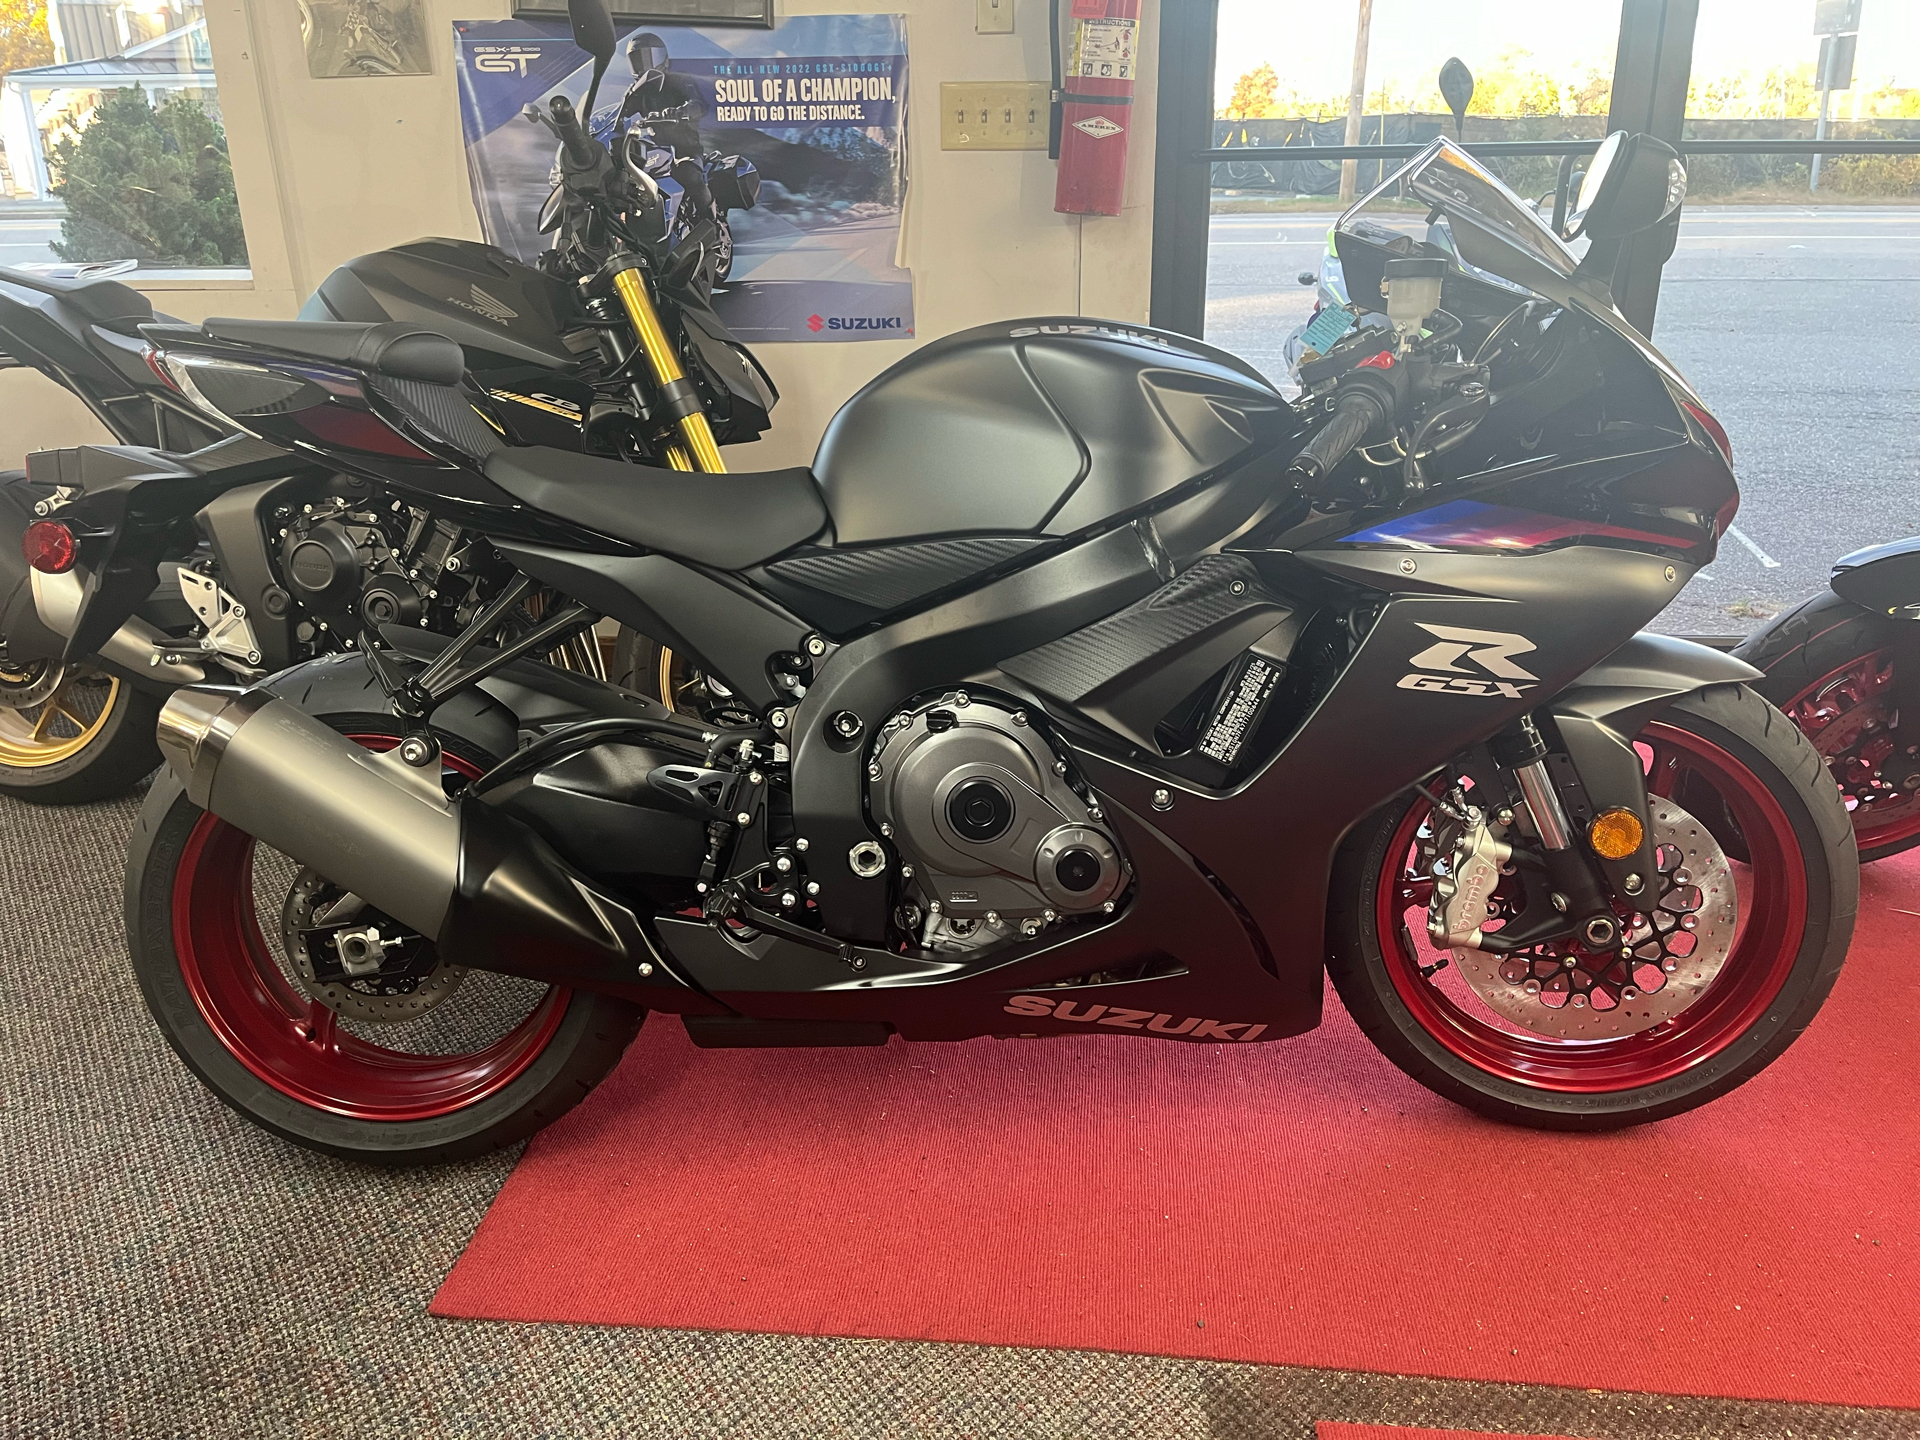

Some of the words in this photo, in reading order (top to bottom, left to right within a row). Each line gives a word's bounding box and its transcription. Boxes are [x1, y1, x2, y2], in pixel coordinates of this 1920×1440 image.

[475, 54, 541, 78] GT
[714, 66, 732, 74] THE
[737, 65, 754, 74] ALL
[760, 65, 780, 74] NEW
[786, 64, 810, 74] 2022
[715, 79, 758, 103] SOUL
[762, 78, 782, 102] OF
[786, 78, 798, 102] A
[800, 76, 896, 104] CHAMPION,
[716, 106, 750, 122] READY
[753, 106, 768, 122] TO
[770, 106, 784, 122] GO
[786, 105, 806, 121] THE
[809, 104, 865, 120] DISTANCE.
[1081, 123, 1116, 131] AMEREX
[446, 296, 509, 326] HONDA
[828, 316, 902, 330] SUZUKI
[1010, 324, 1168, 349] SUZUKI
[1408, 622, 1540, 681] R
[1396, 673, 1539, 699] GSX
[1452, 864, 1488, 930] brembo
[1004, 996, 1268, 1041] SUZUKI
